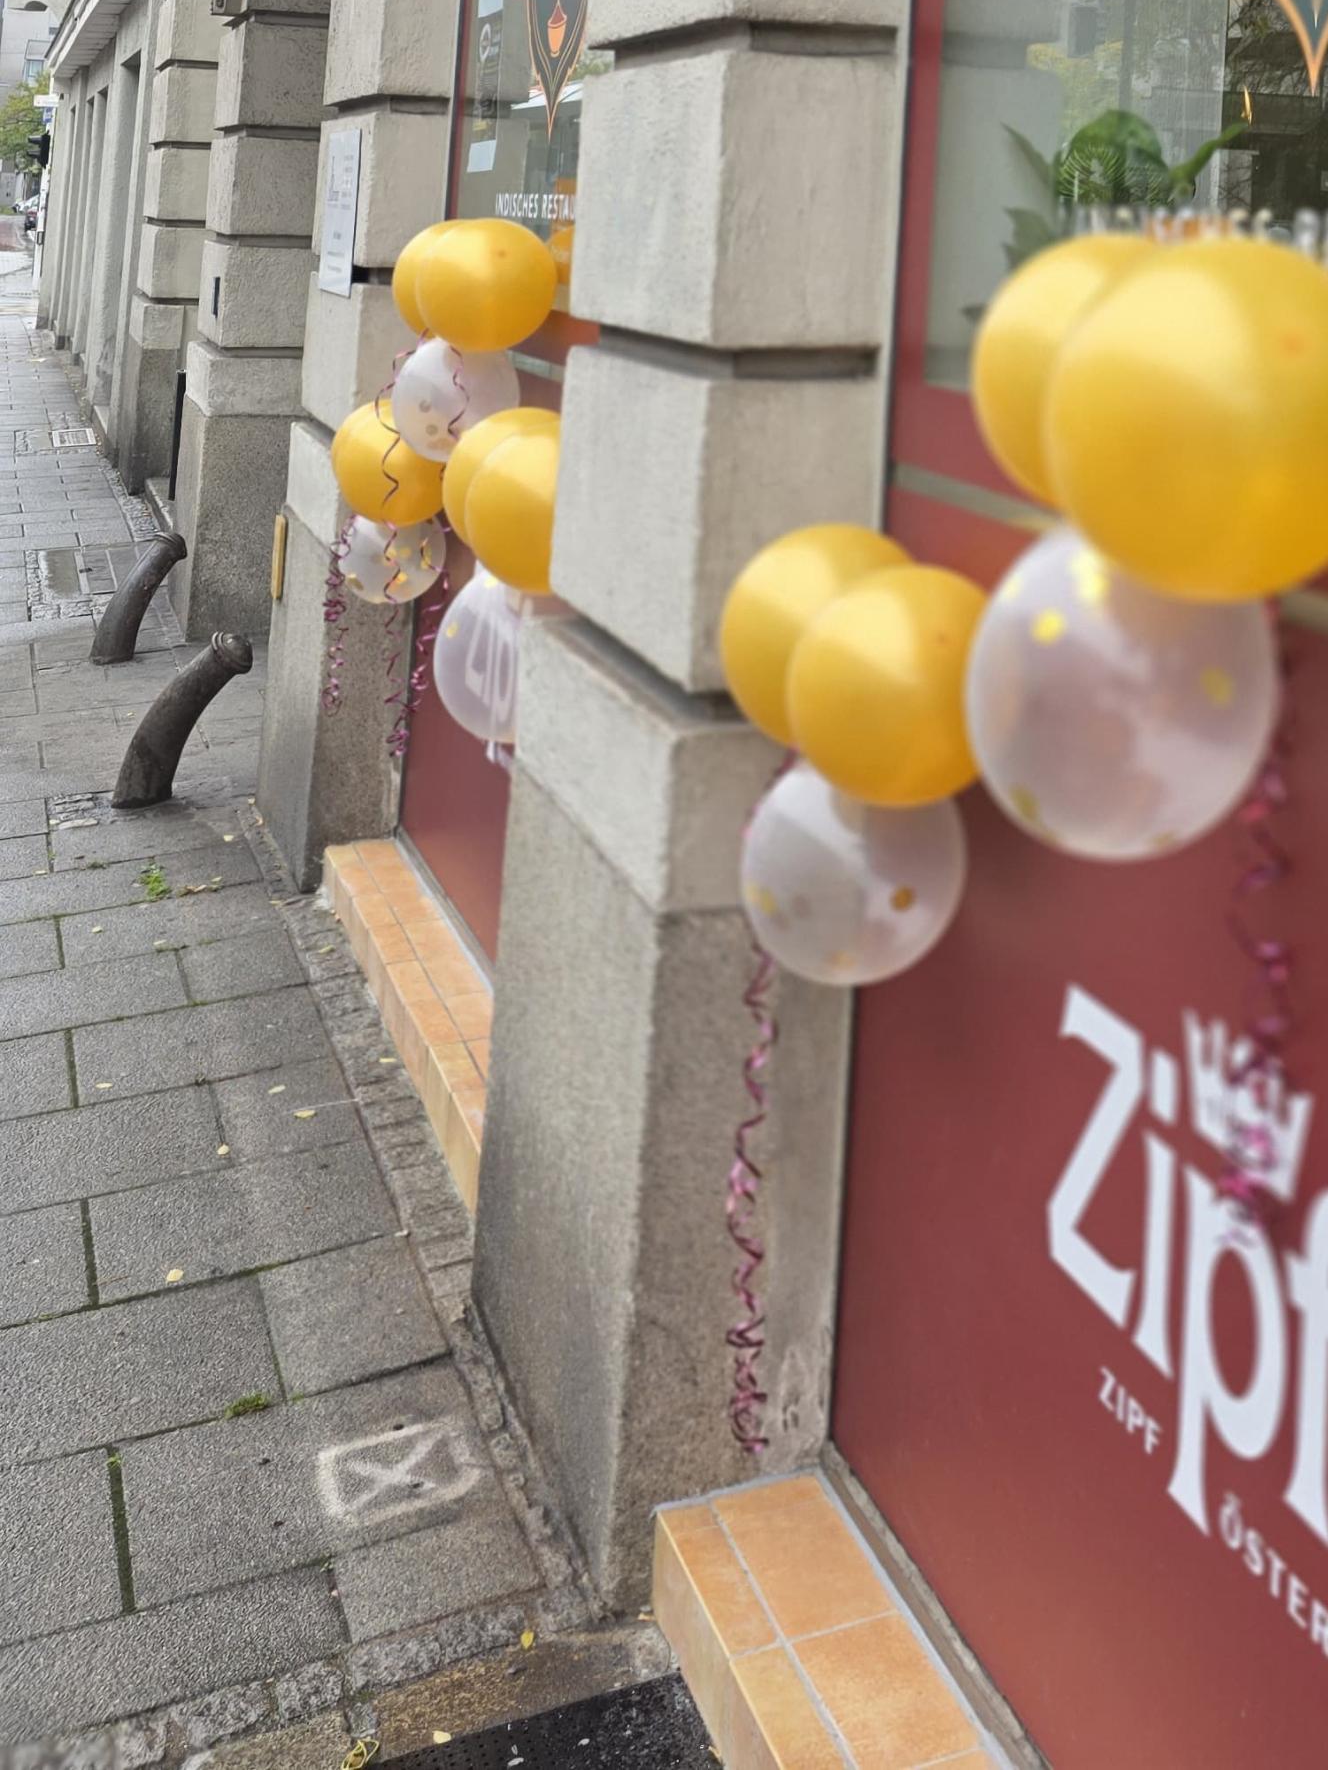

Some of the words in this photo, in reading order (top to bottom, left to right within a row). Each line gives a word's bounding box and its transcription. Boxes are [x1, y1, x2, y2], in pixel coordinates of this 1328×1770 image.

[495, 192, 538, 218] INDISCHES
[541, 193, 576, 220] RESTAU
[1098, 1366, 1163, 1457] ZIPF
